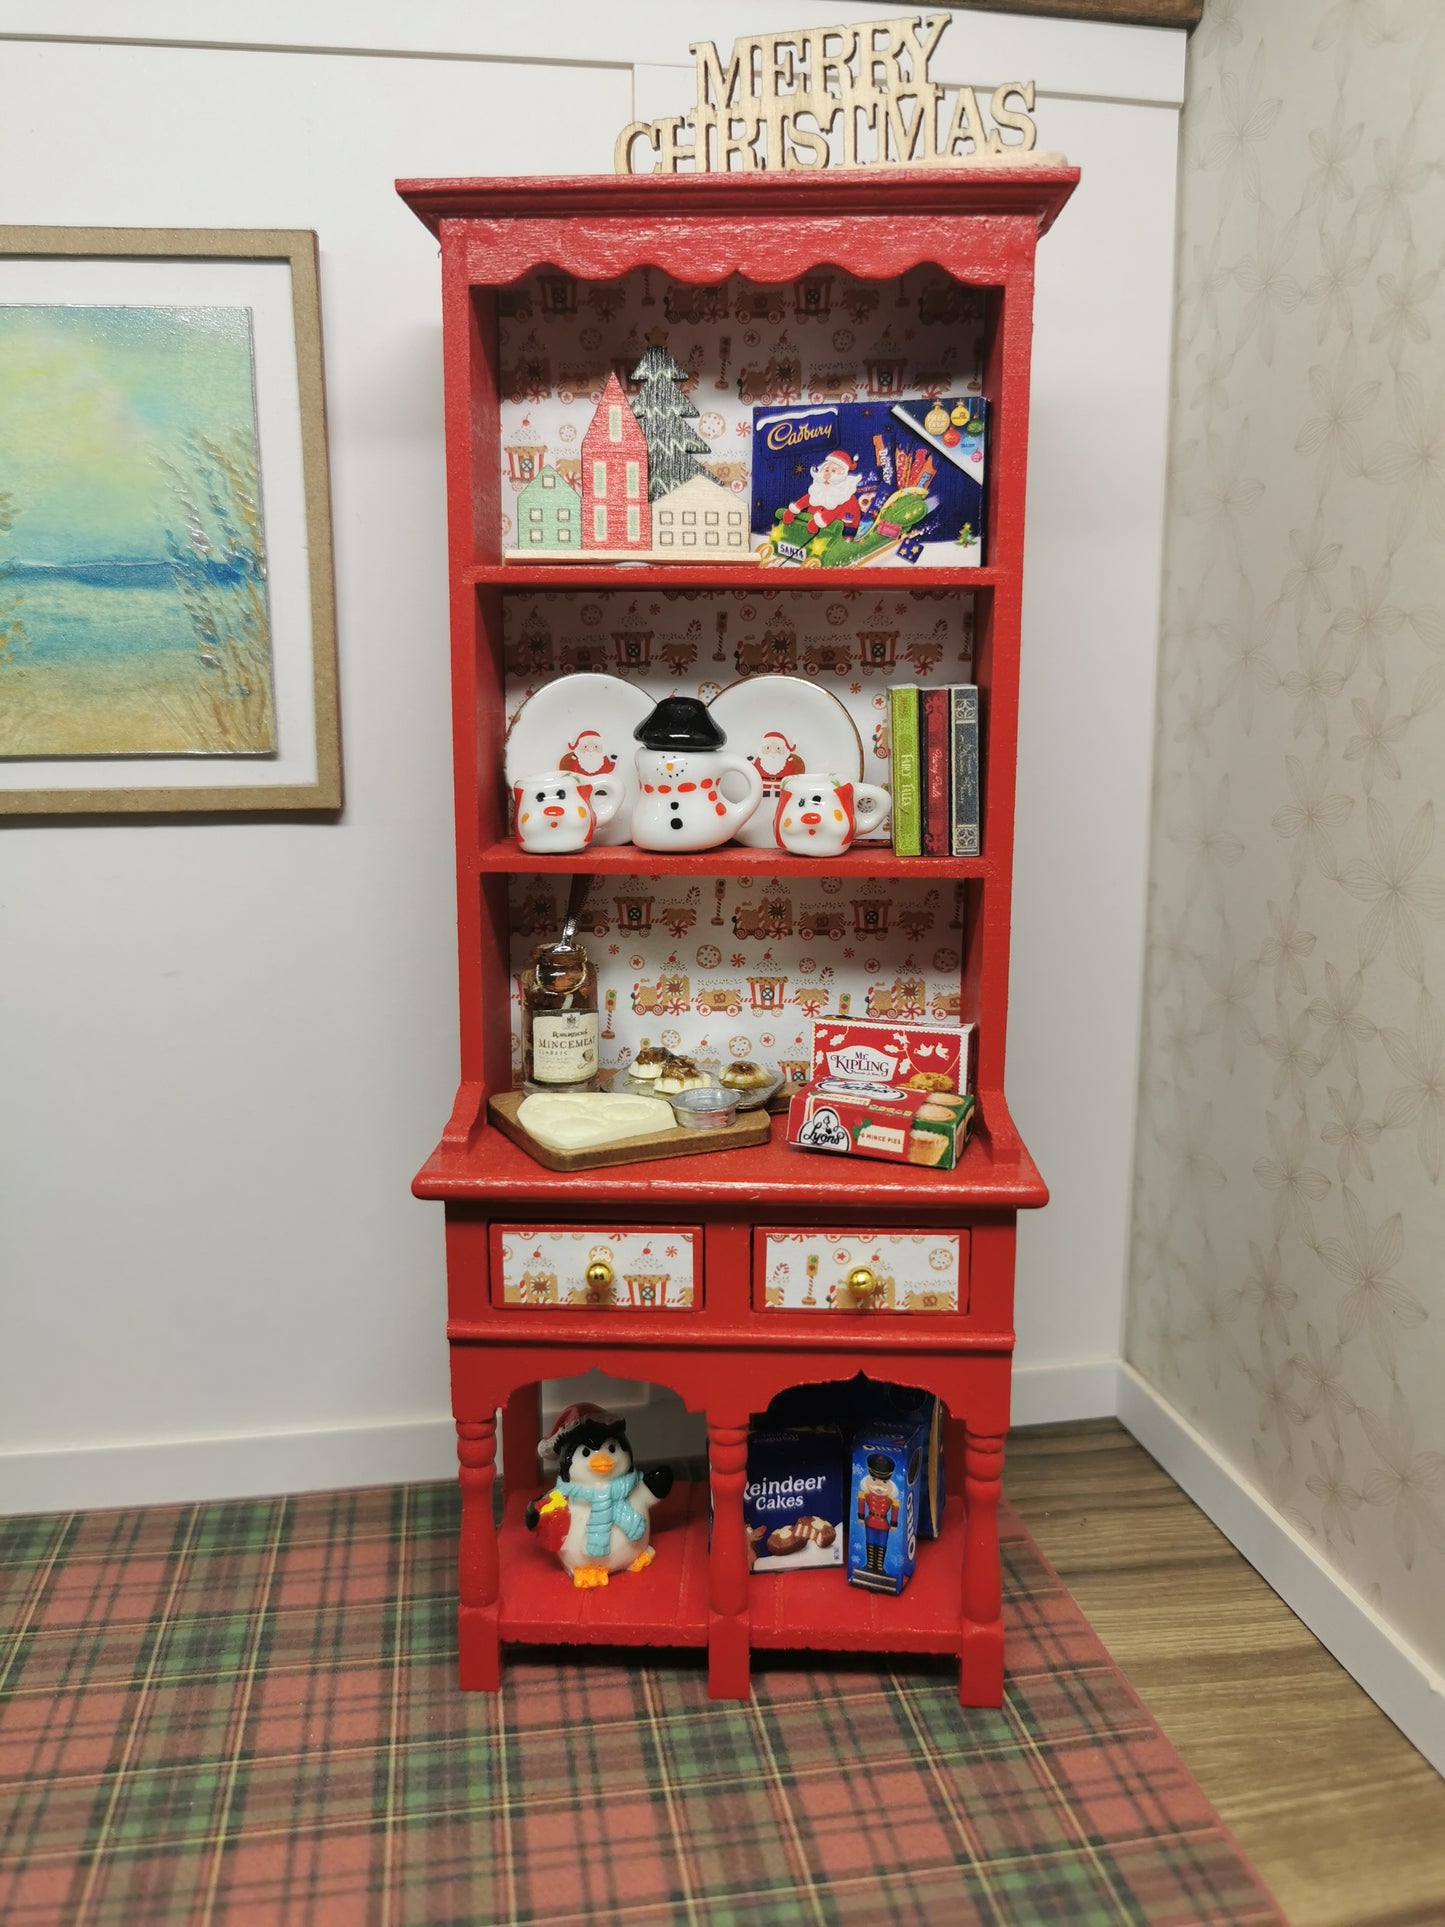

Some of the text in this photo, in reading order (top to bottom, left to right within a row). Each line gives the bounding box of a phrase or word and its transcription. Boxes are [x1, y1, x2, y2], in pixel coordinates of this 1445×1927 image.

[689, 13, 952, 112] MERRY
[614, 79, 1037, 174] CHRISTMAS
[767, 422, 832, 451] Cadbury
[538, 1036, 595, 1049] MINCEMEAT
[830, 1054, 889, 1077] KIPLING
[803, 1121, 845, 1146] Lyons
[756, 1495, 804, 1511] Cakes
